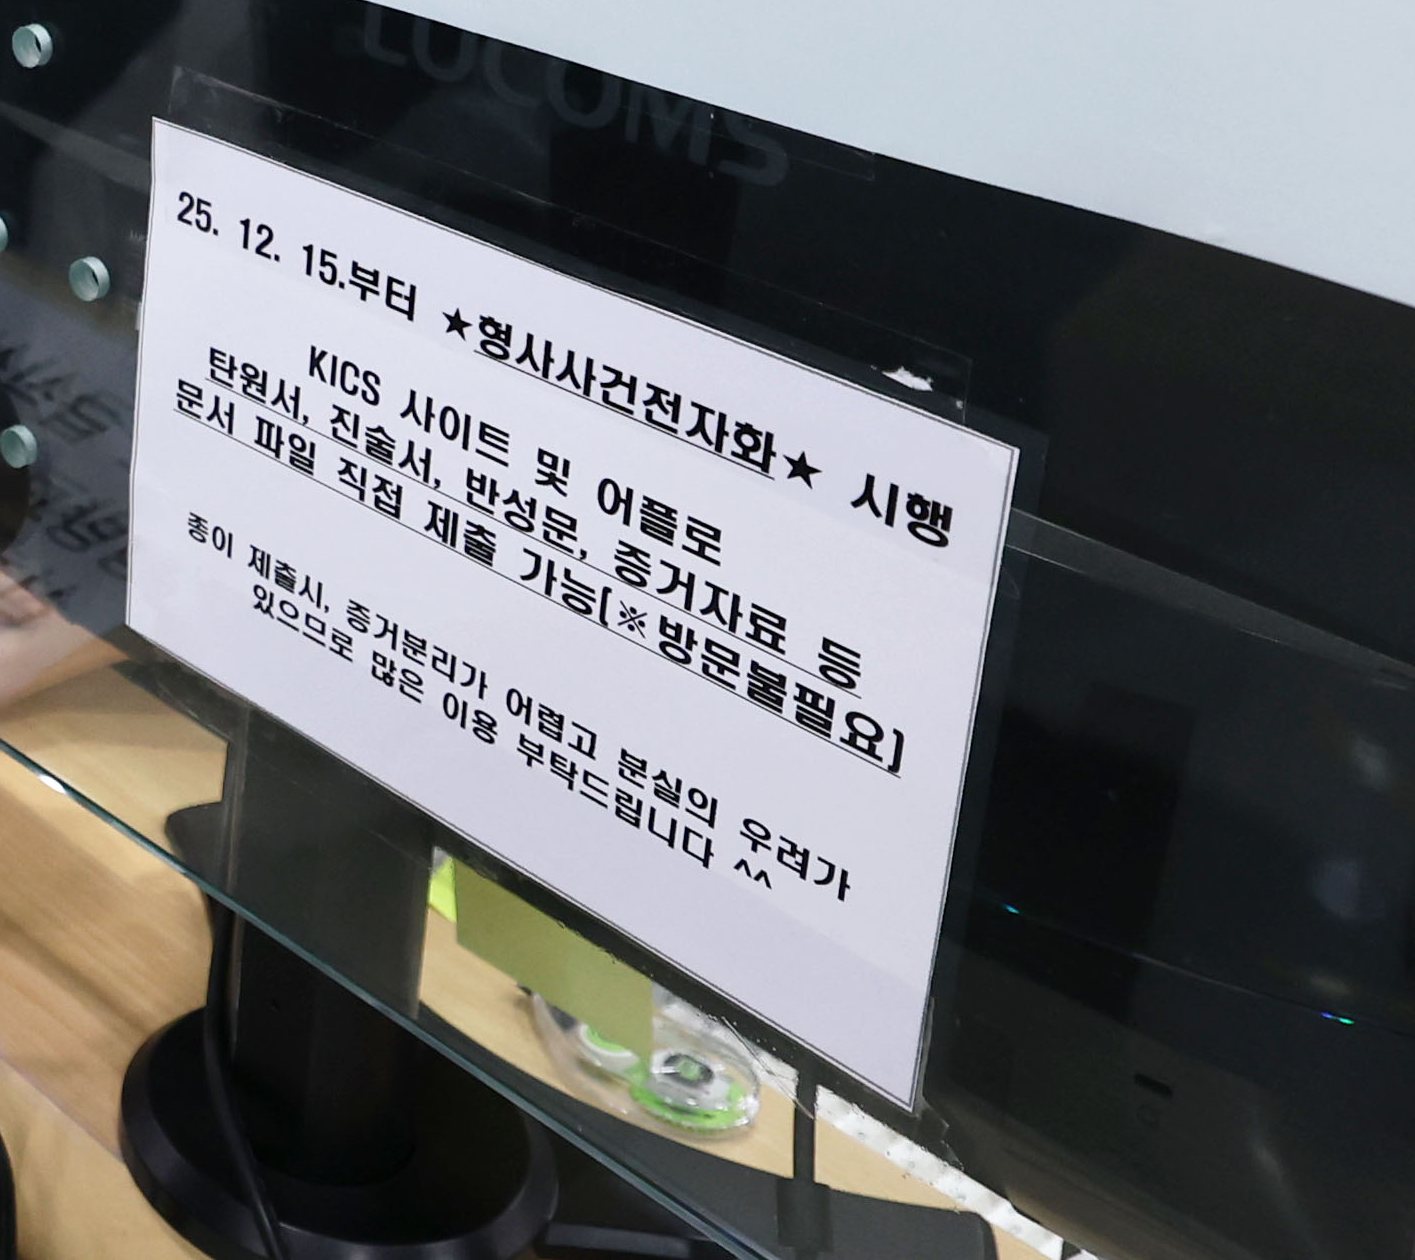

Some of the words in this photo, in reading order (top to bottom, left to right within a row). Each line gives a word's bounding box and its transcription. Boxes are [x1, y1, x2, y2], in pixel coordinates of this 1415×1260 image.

[175, 378, 236, 434] 문서
[254, 416, 316, 475] 파일
[338, 457, 402, 520] 직접
[424, 504, 496, 566] 제출
[177, 191, 219, 236] 25.
[239, 218, 280, 262] 12.
[302, 244, 417, 322] 15.부터
[850, 473, 953, 548] 시행
[208, 347, 309, 424] 탄원서,
[330, 404, 441, 490] 진술서,
[465, 468, 587, 560] 반성문,
[614, 539, 787, 655] 증거자료
[818, 637, 861, 691] 등
[309, 345, 381, 406] KICS
[400, 389, 510, 468] 사이트
[534, 447, 571, 497] 및
[597, 478, 722, 568] 어플로
[188, 512, 233, 559] 종이
[247, 544, 329, 613] 제출시,
[346, 599, 488, 704] 증거분리가
[506, 688, 597, 761] 어렵고
[615, 748, 718, 829] 분실의
[740, 818, 851, 902] 우려가
[253, 581, 353, 663] 있으므로
[371, 647, 425, 704] 많은
[443, 692, 498, 745] 이용
[517, 733, 718, 869] 부탁드립니다
